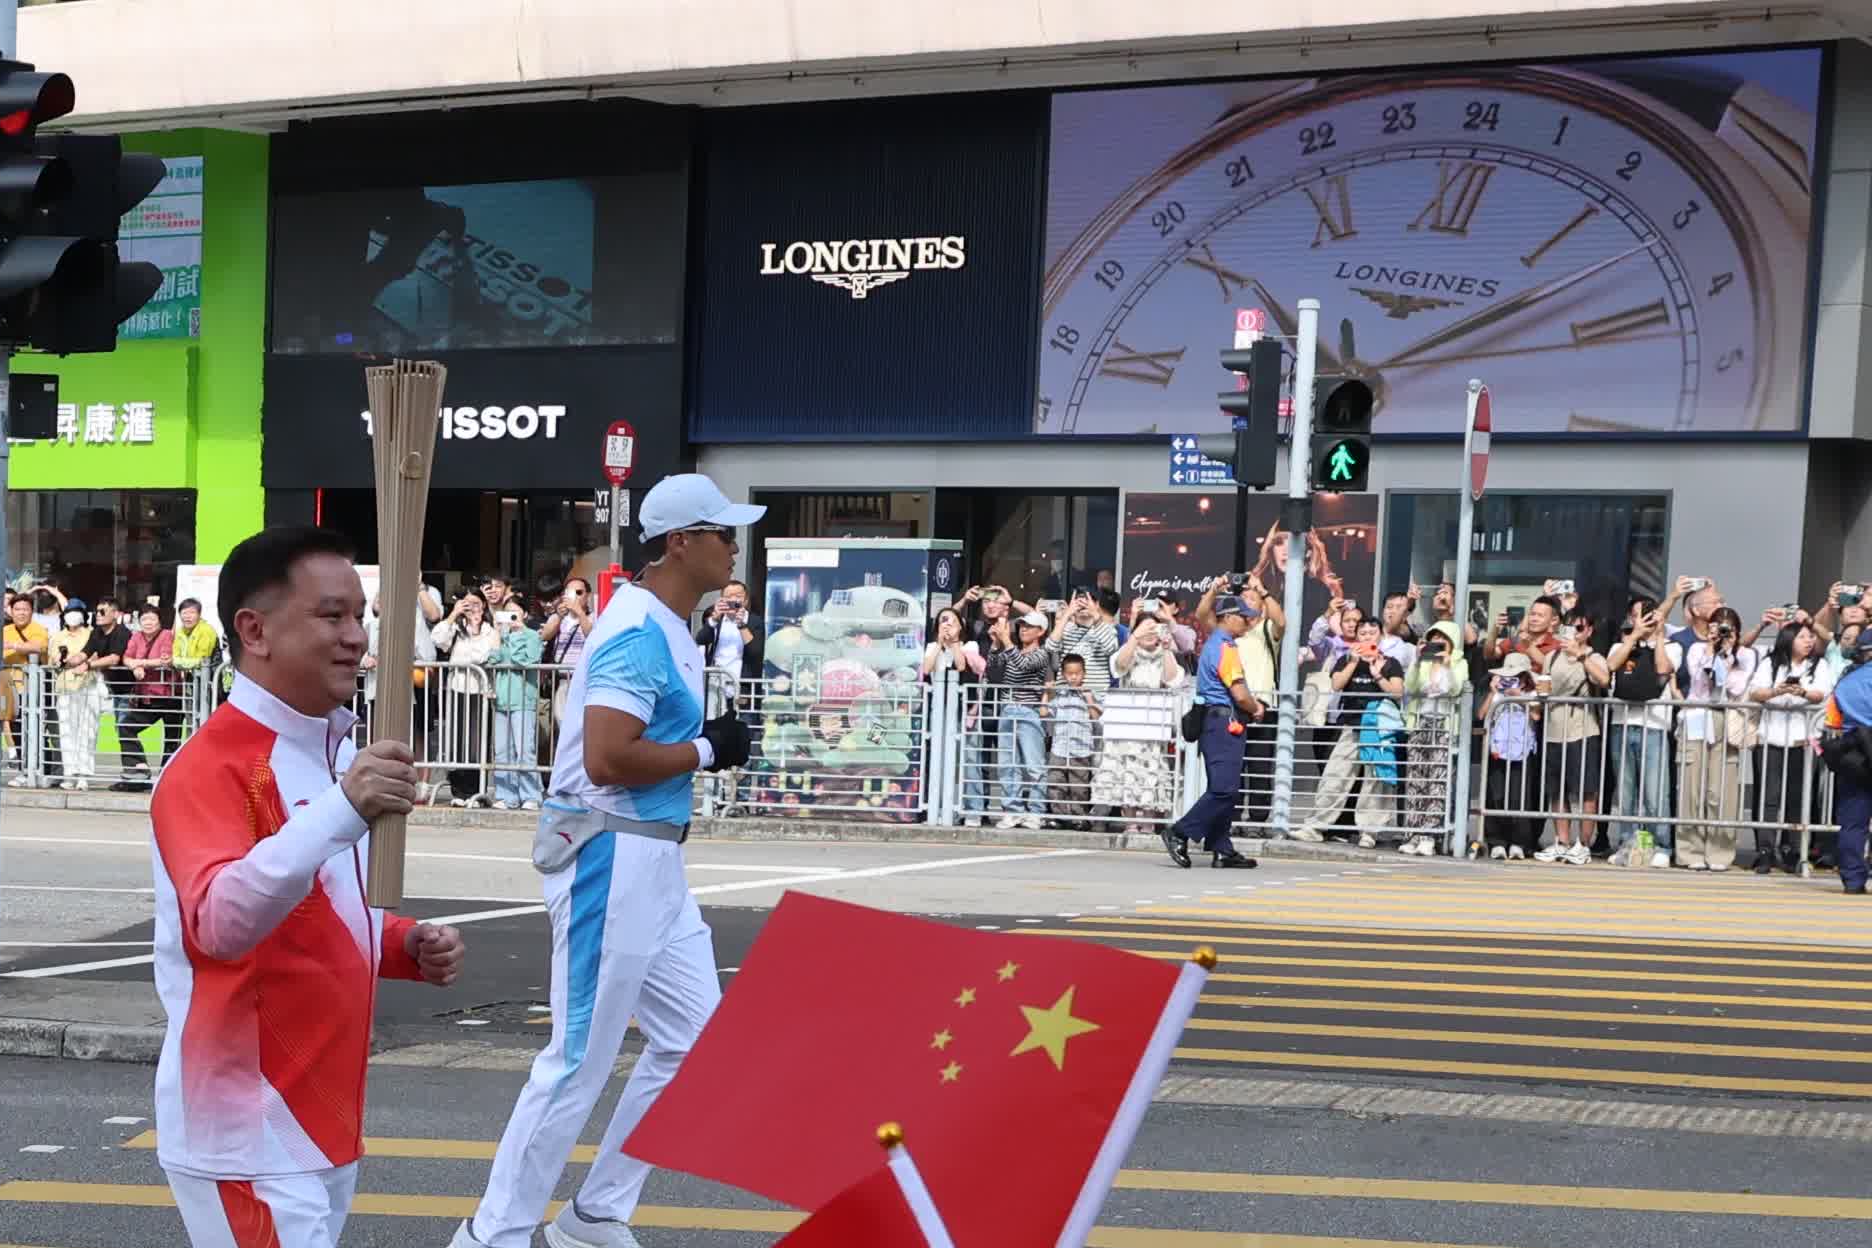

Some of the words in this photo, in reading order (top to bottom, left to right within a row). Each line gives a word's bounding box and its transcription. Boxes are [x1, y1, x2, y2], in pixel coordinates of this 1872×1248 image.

[1382, 103, 1417, 133] 23
[1463, 102, 1500, 131] 24
[1553, 116, 1569, 145] 1
[1299, 122, 1336, 155] 22
[1225, 156, 1256, 188] 21
[1616, 152, 1642, 180] 2
[1151, 201, 1186, 237] 20
[1673, 200, 1700, 229] 3
[760, 236, 966, 276] LONGINES
[1094, 260, 1125, 292] 19
[1335, 261, 1500, 297] LONGINES
[1708, 271, 1734, 297] 4
[1050, 324, 1080, 355] 18
[438, 405, 566, 439] ISSOT
[596, 490, 610, 507] YT
[595, 508, 610, 523] 907
